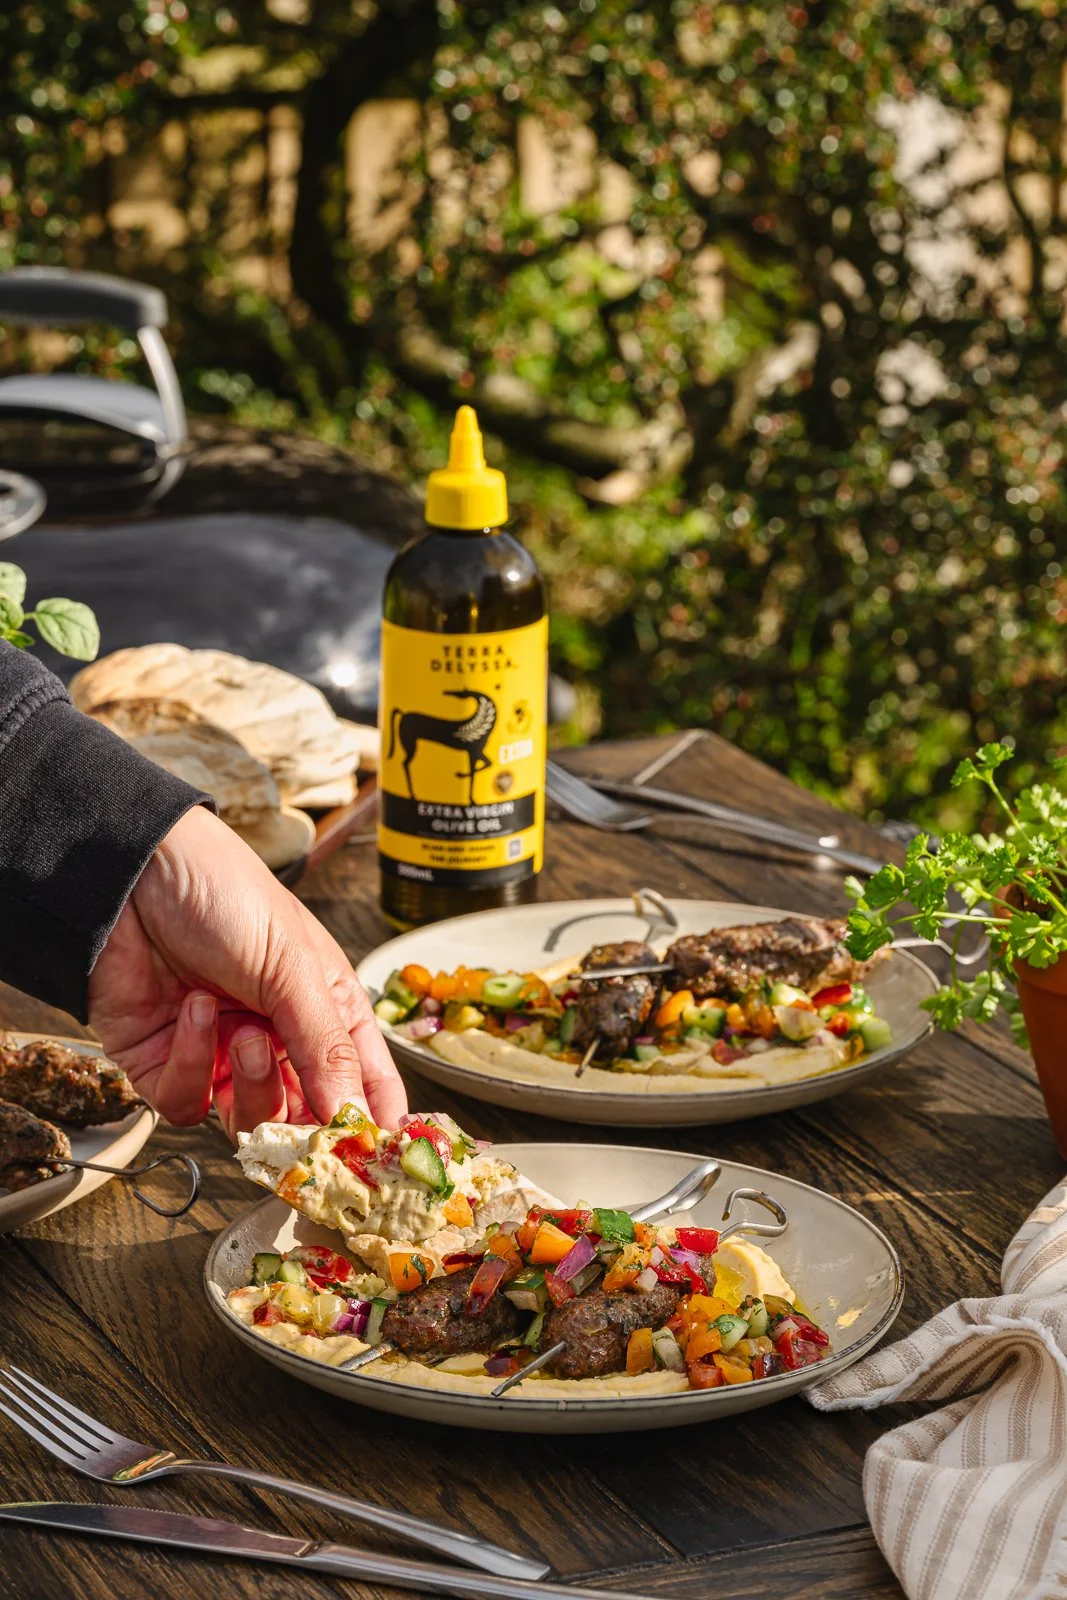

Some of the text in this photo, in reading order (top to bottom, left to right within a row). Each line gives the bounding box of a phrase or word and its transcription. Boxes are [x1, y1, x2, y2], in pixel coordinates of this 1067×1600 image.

[442, 645, 504, 658] TERRA
[430, 658, 512, 673] DELYSSA
[418, 801, 515, 819] EXTRA VIRGIN
[432, 818, 502, 833] OLIVE OIL
